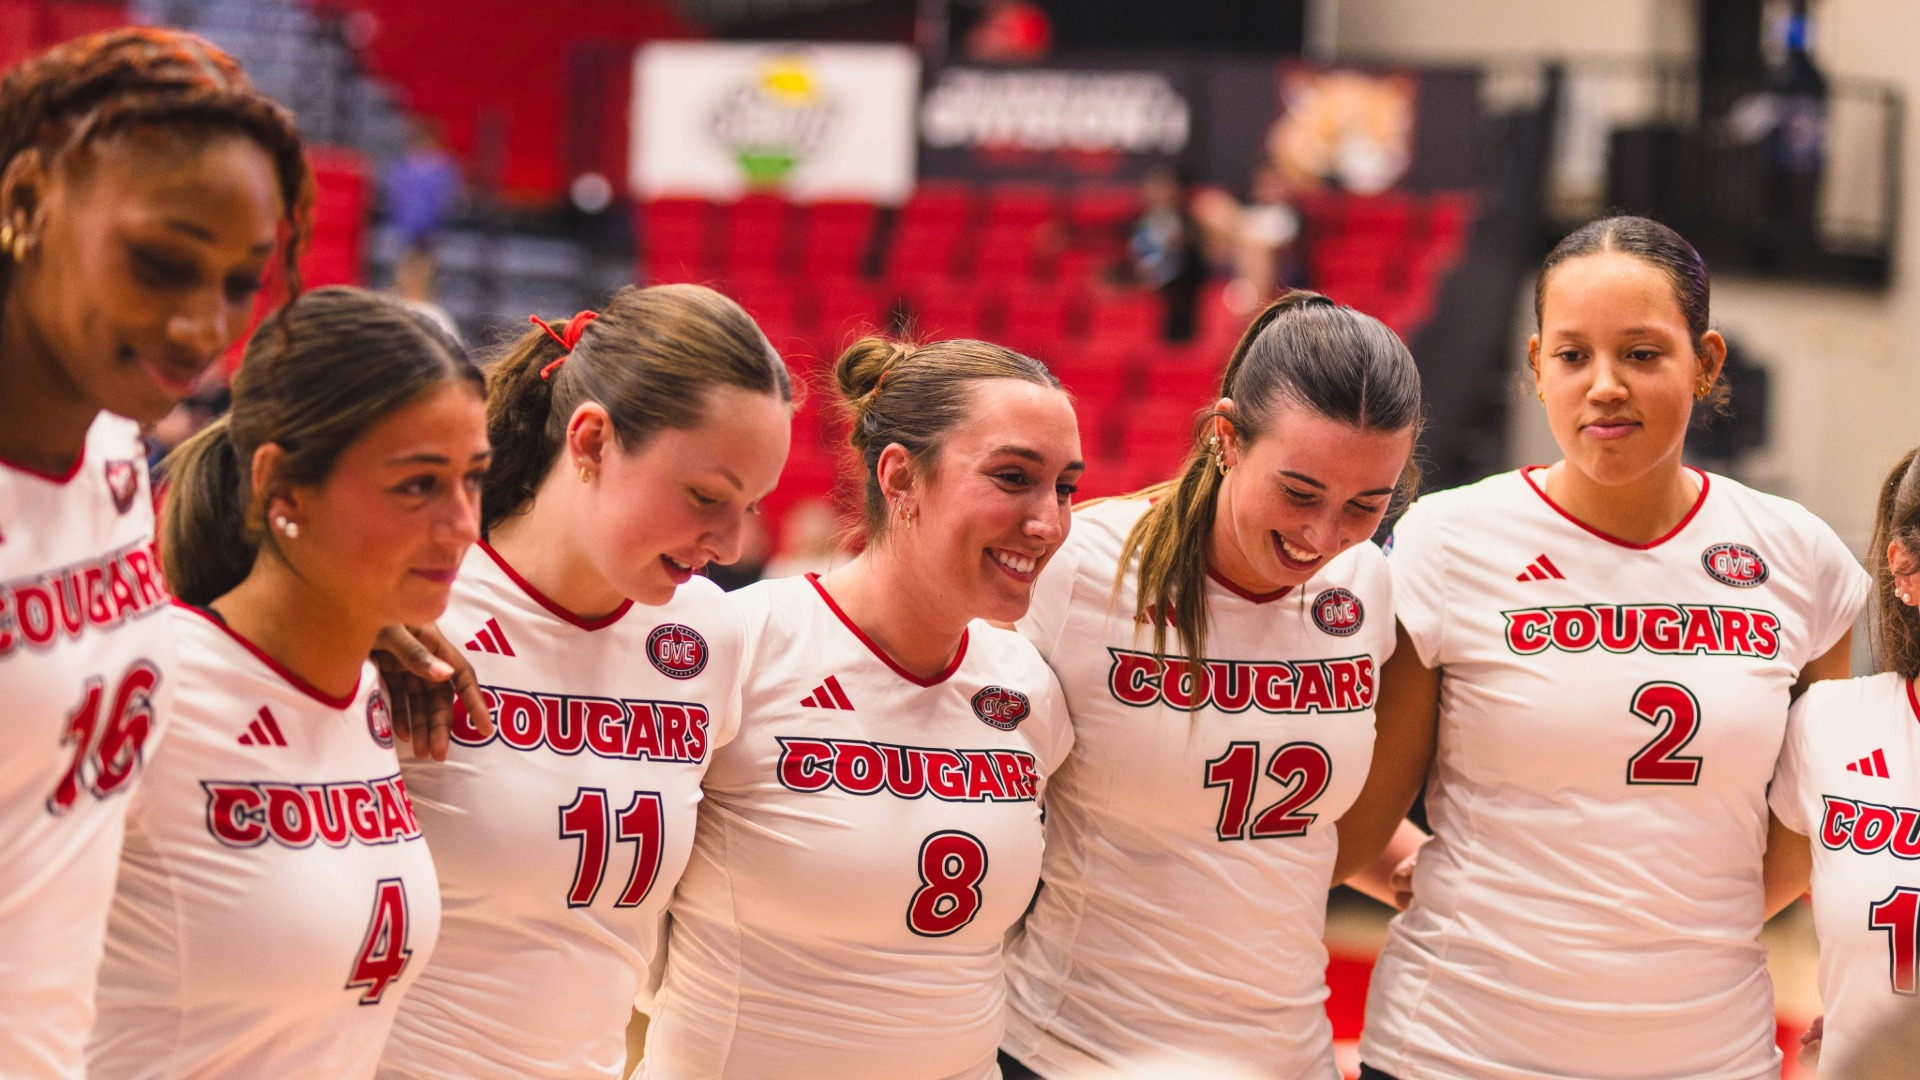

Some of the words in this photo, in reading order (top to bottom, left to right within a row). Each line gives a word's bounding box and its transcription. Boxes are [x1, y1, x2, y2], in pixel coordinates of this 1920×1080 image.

[0, 536, 167, 655] OUGAR
[1323, 601, 1356, 625] OVC
[1715, 554, 1755, 579] OVC
[659, 639, 696, 665] OVC
[1107, 647, 1374, 715] COUGARS
[1500, 604, 1781, 659] COUGARS
[46, 658, 162, 816] 16
[776, 736, 1040, 803] COUGARS
[1626, 681, 1703, 786] 2
[1204, 741, 1332, 841] 12
[558, 787, 665, 909] 11
[907, 830, 988, 938] 8
[345, 877, 412, 1005] 4
[1868, 886, 1920, 996] 1
